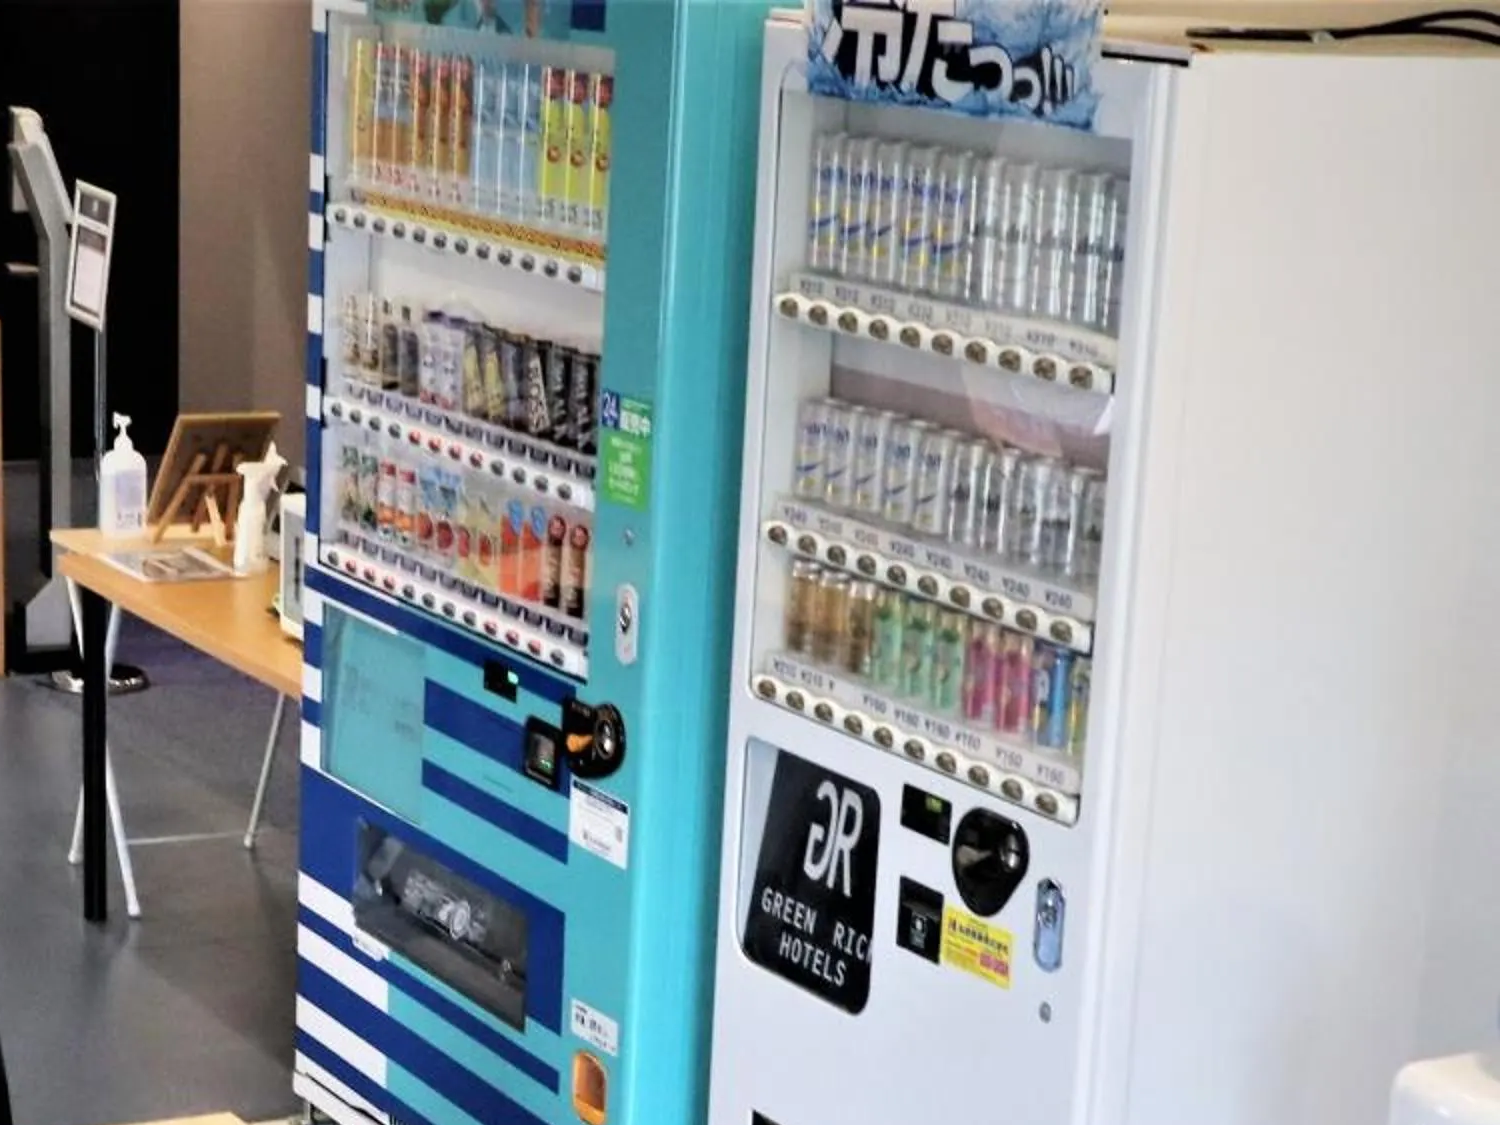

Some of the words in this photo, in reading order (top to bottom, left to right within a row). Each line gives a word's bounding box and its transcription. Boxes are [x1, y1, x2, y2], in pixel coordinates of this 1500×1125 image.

[761, 887, 817, 935] GREEN
[832, 920, 873, 964] RIC
[779, 931, 847, 987] HOTELS
